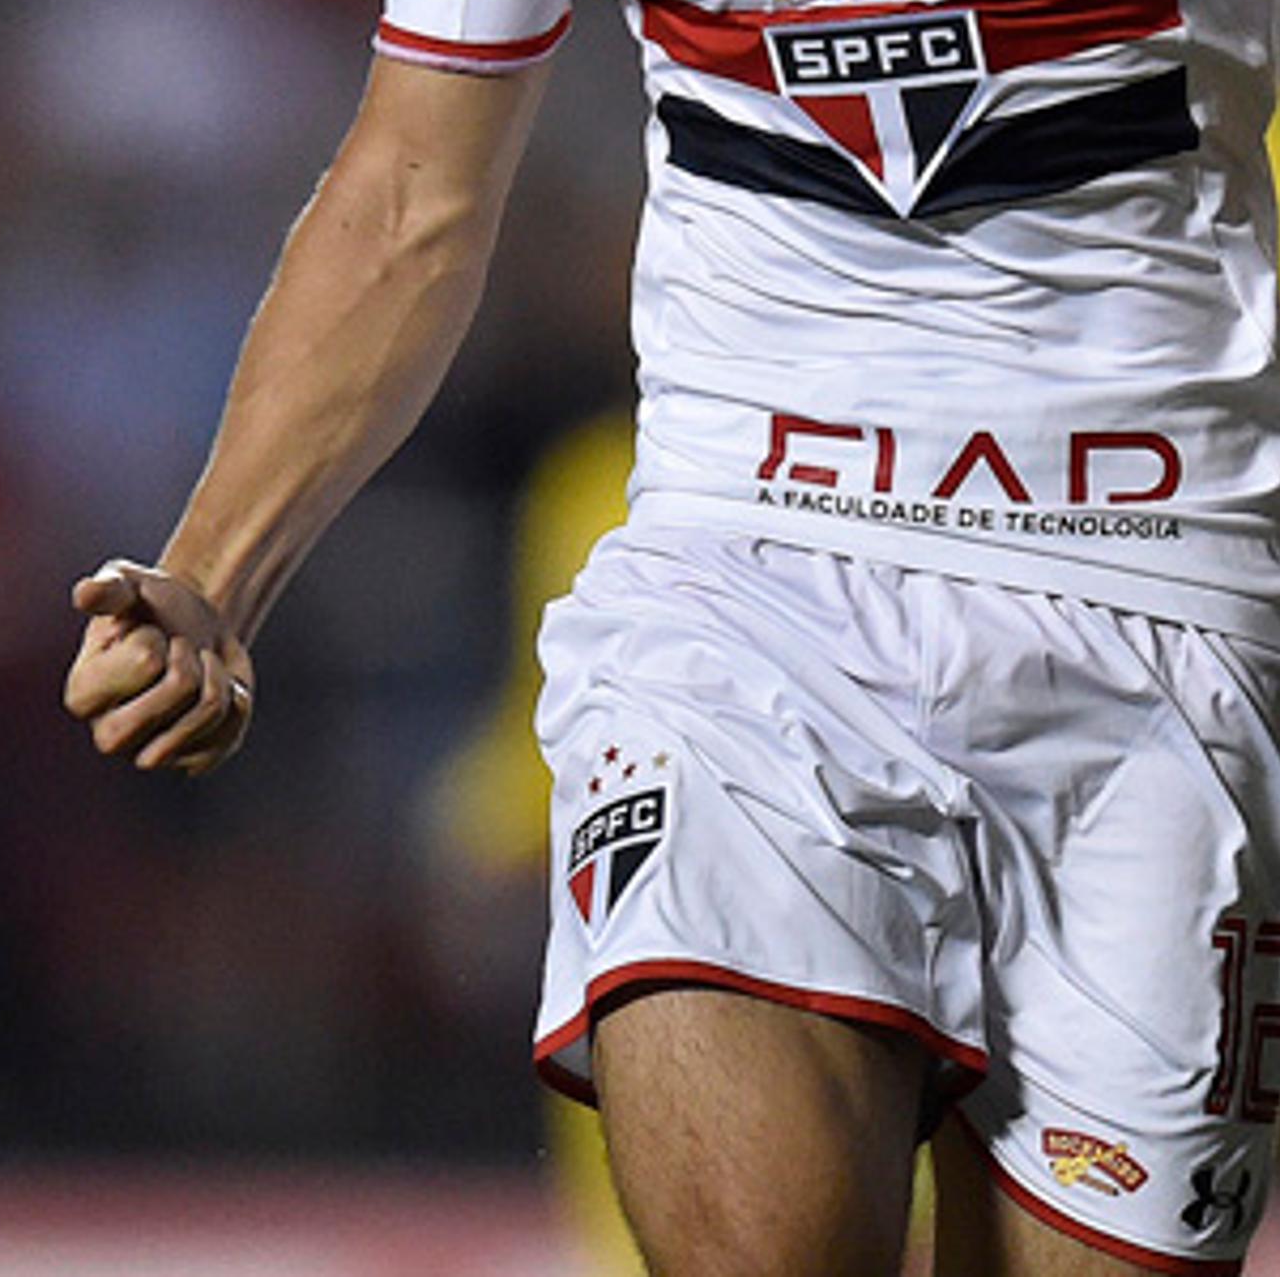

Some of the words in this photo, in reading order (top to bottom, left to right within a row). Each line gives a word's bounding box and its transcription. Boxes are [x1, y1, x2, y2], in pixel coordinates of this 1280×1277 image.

[791, 28, 960, 79] SPFC
[757, 487, 776, 505] A
[784, 491, 948, 526] FACULDADE
[959, 508, 993, 530] DE
[1006, 512, 1183, 539] TECNOLOGIA
[575, 798, 658, 860] SPFC
